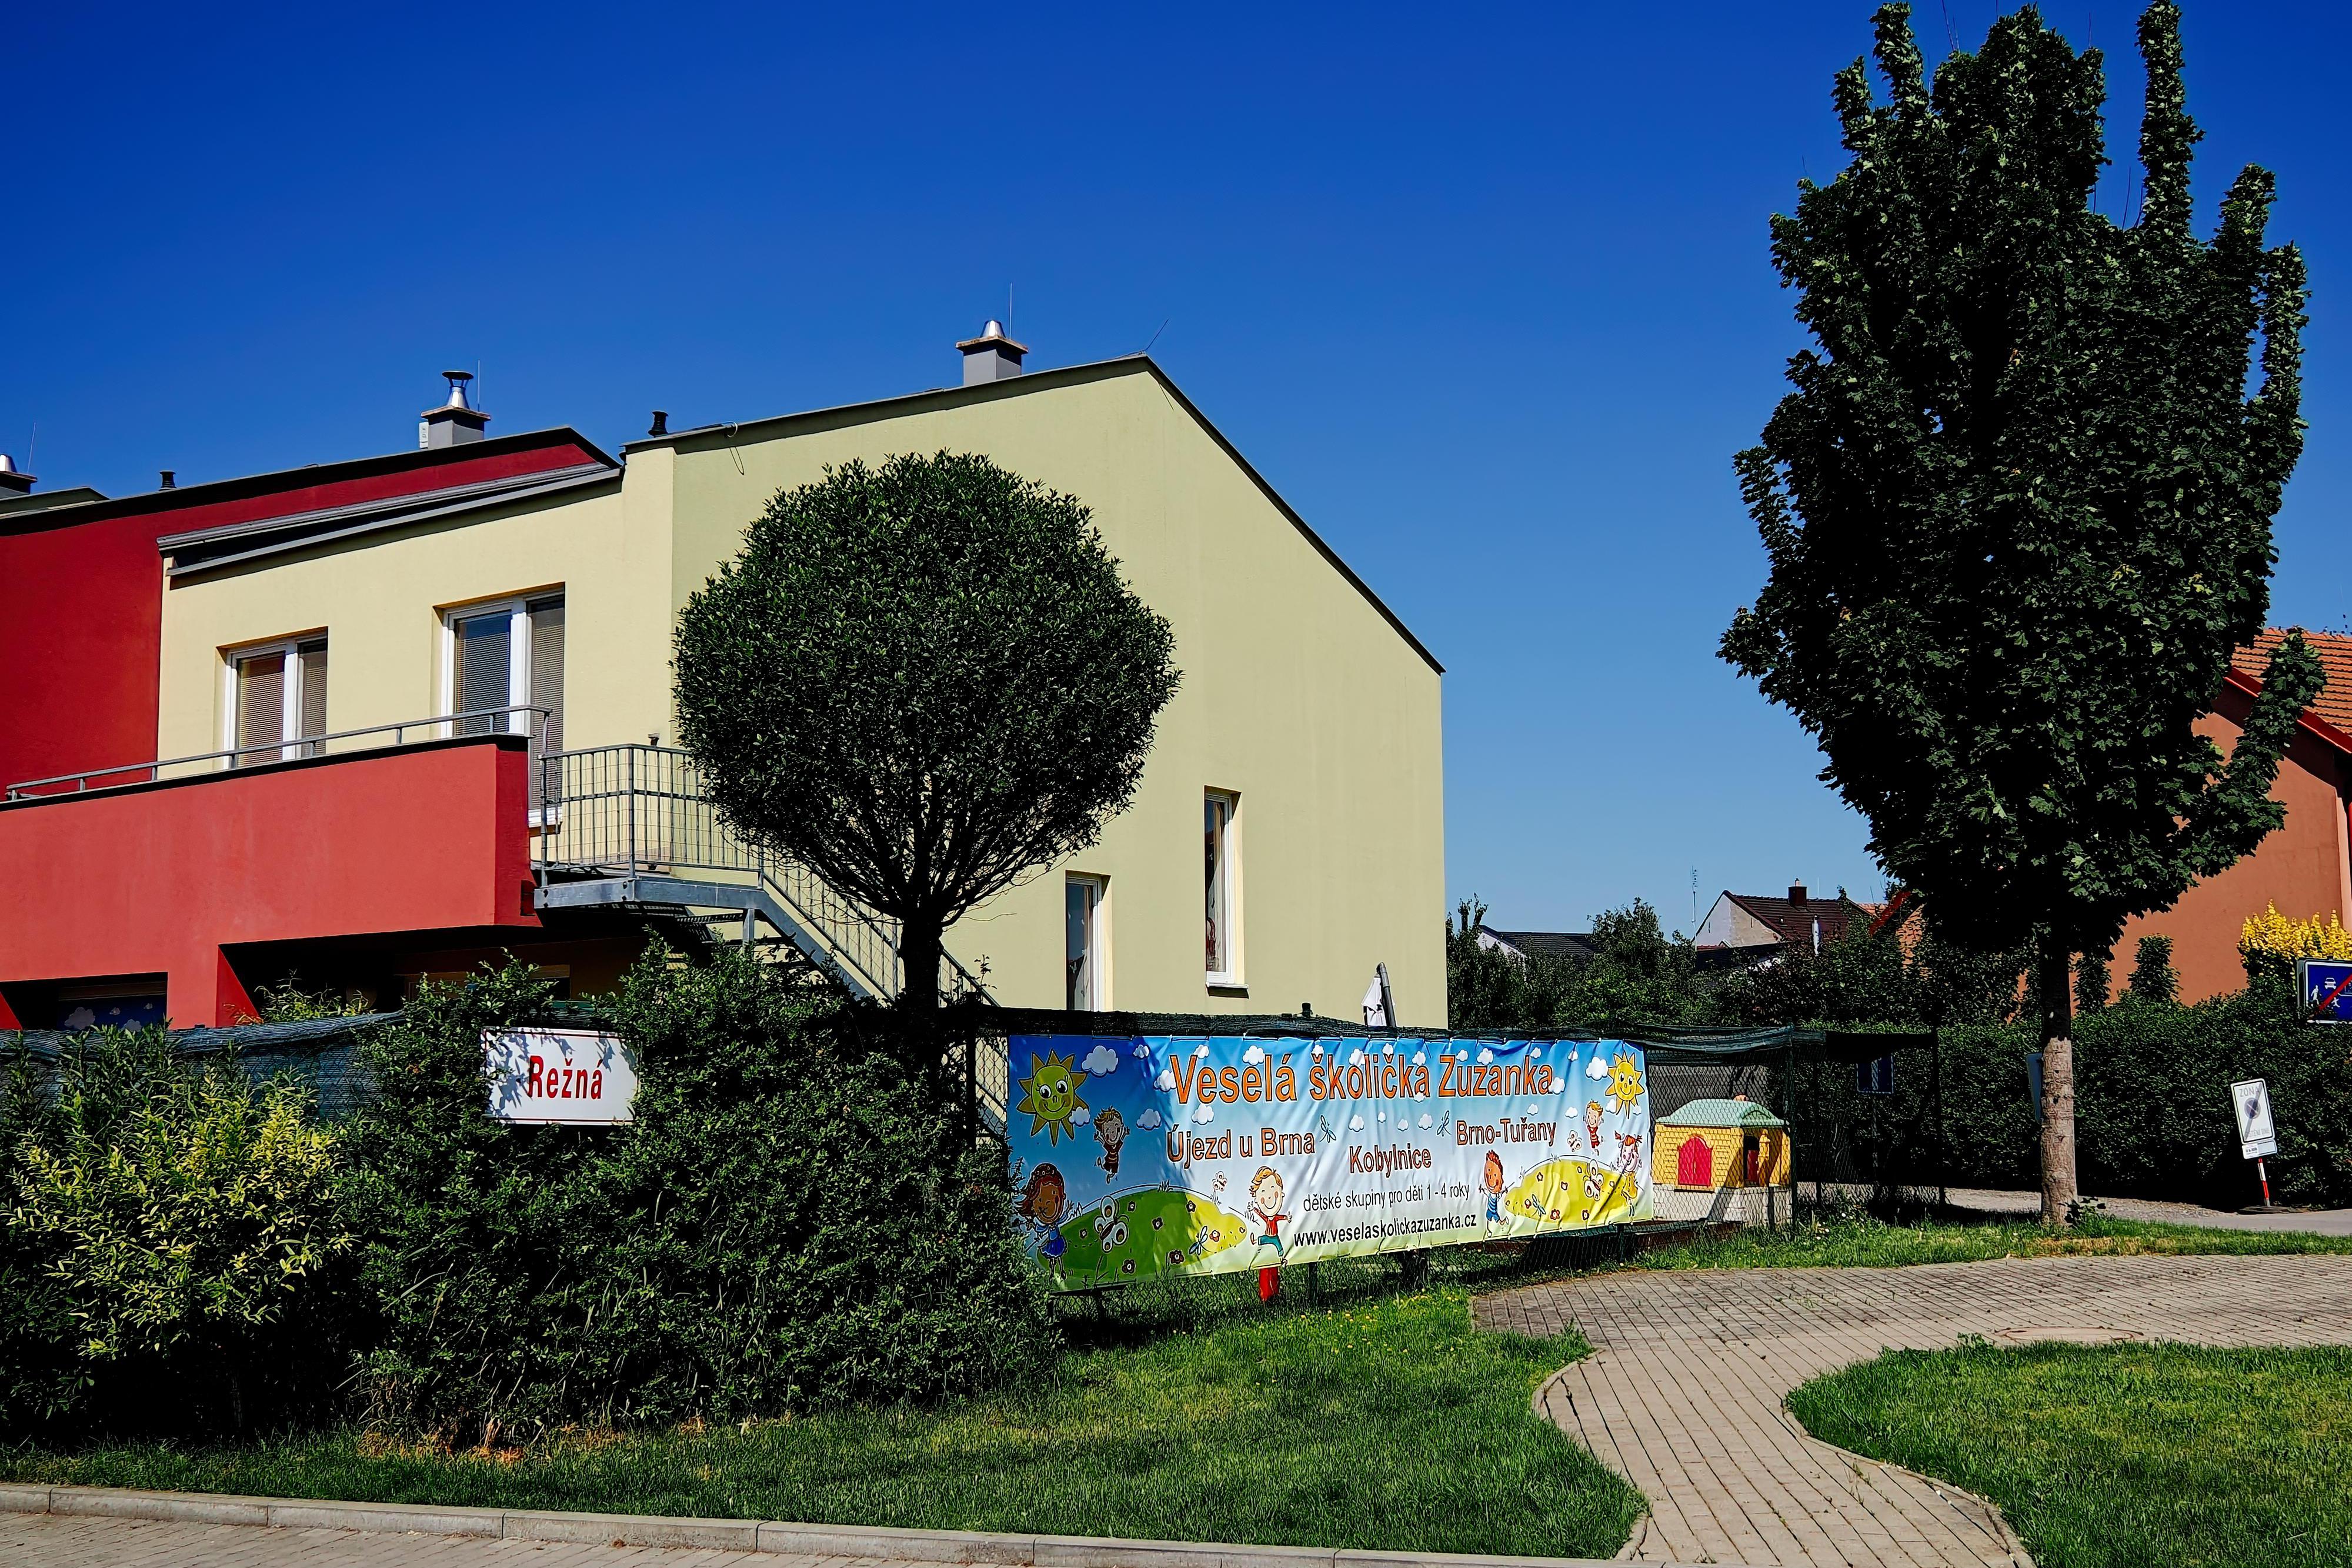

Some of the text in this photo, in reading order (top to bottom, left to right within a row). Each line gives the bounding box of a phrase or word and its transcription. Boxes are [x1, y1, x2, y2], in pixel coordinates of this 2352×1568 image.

[528, 1055, 603, 1100] Režná
[1169, 1053, 1554, 1104] Veselá školička Zuzanka
[1167, 1124, 1315, 1169] Újezd u Brna
[1456, 1117, 1557, 1147] Brno-Tuřany
[1349, 1143, 1432, 1178] Kobylnice
[1303, 1192, 1342, 1212] dětské
[1345, 1188, 1386, 1210] skupiny
[1389, 1190, 1402, 1207] pro
[1405, 1185, 1423, 1202] děti
[1426, 1184, 1431, 1200] 1
[1440, 1183, 1446, 1199] 4
[1450, 1182, 1469, 1201] roky
[1294, 1212, 1477, 1247] www.veselaskolickazuzanka.cz
